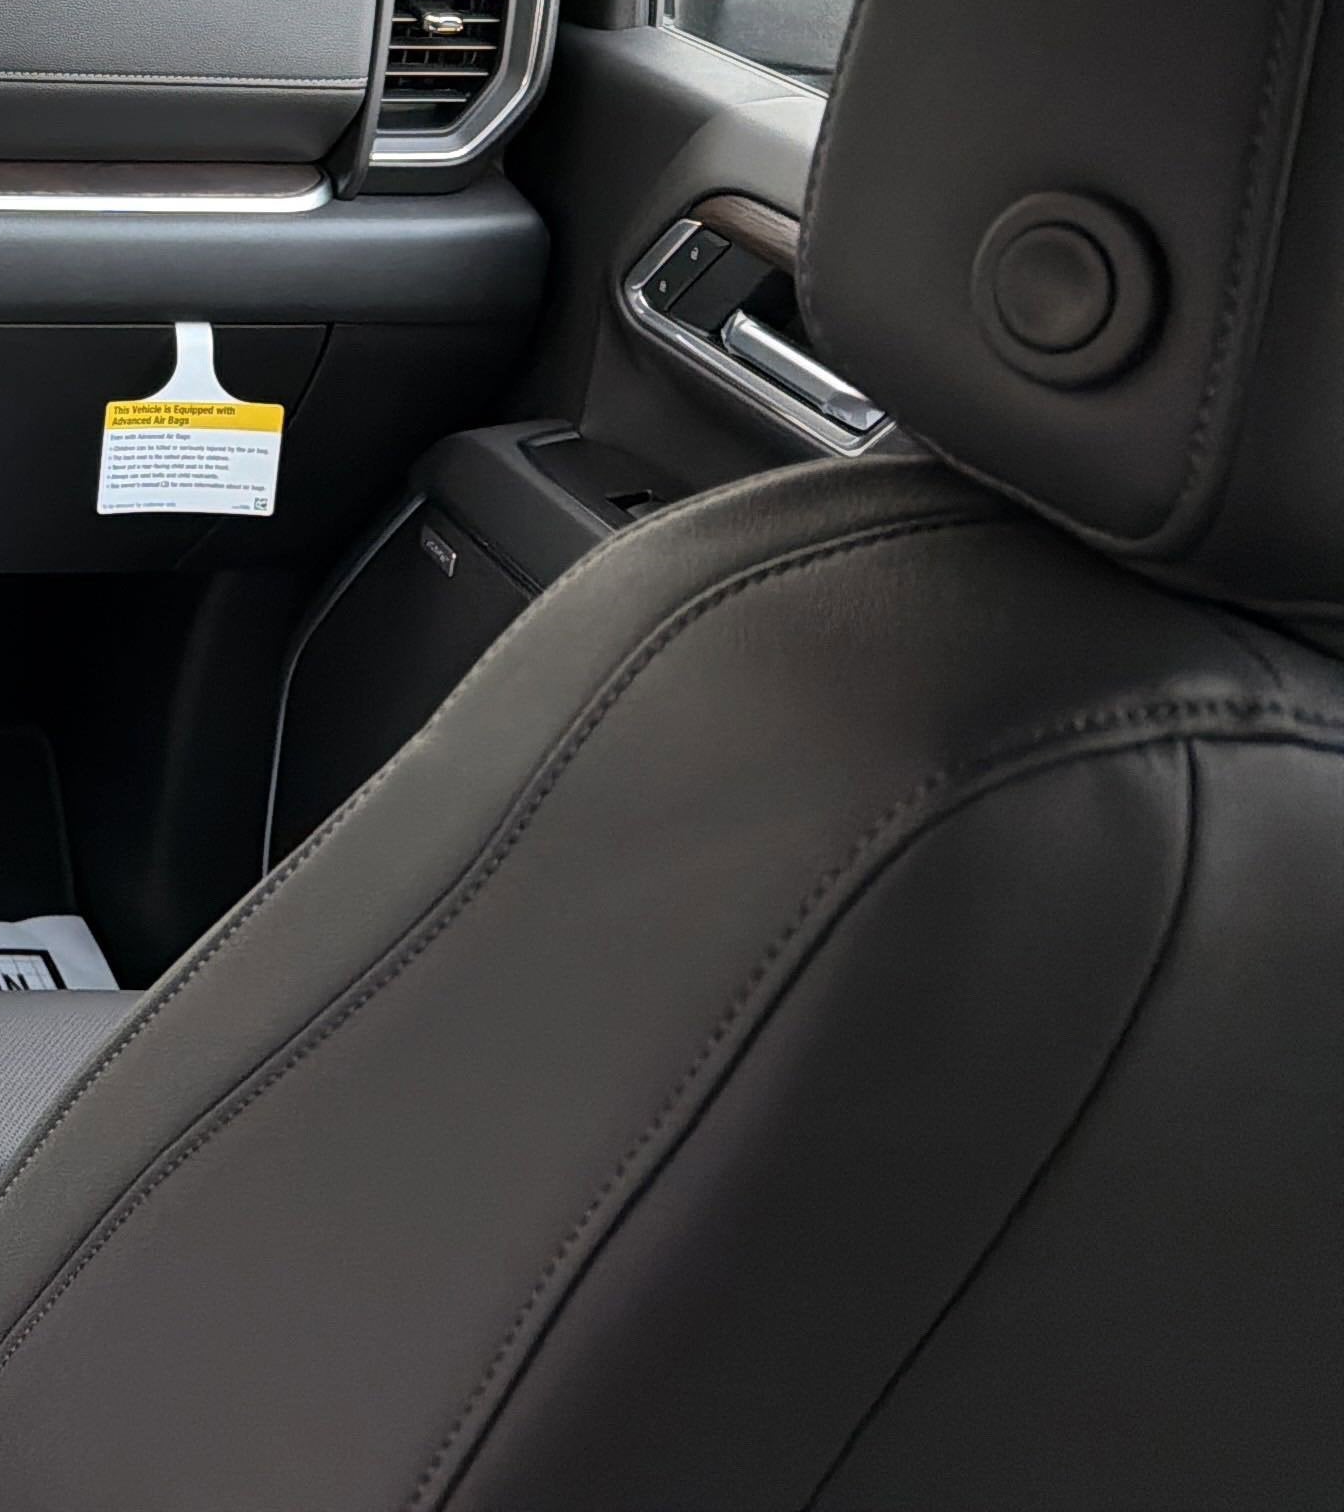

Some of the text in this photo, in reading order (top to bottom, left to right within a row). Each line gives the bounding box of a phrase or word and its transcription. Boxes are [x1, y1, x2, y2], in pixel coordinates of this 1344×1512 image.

[113, 405, 130, 415] This
[132, 405, 162, 414] Vehicle
[173, 405, 214, 416] Equipped
[216, 406, 236, 416] with
[112, 415, 190, 427] Advanced Air Bags
